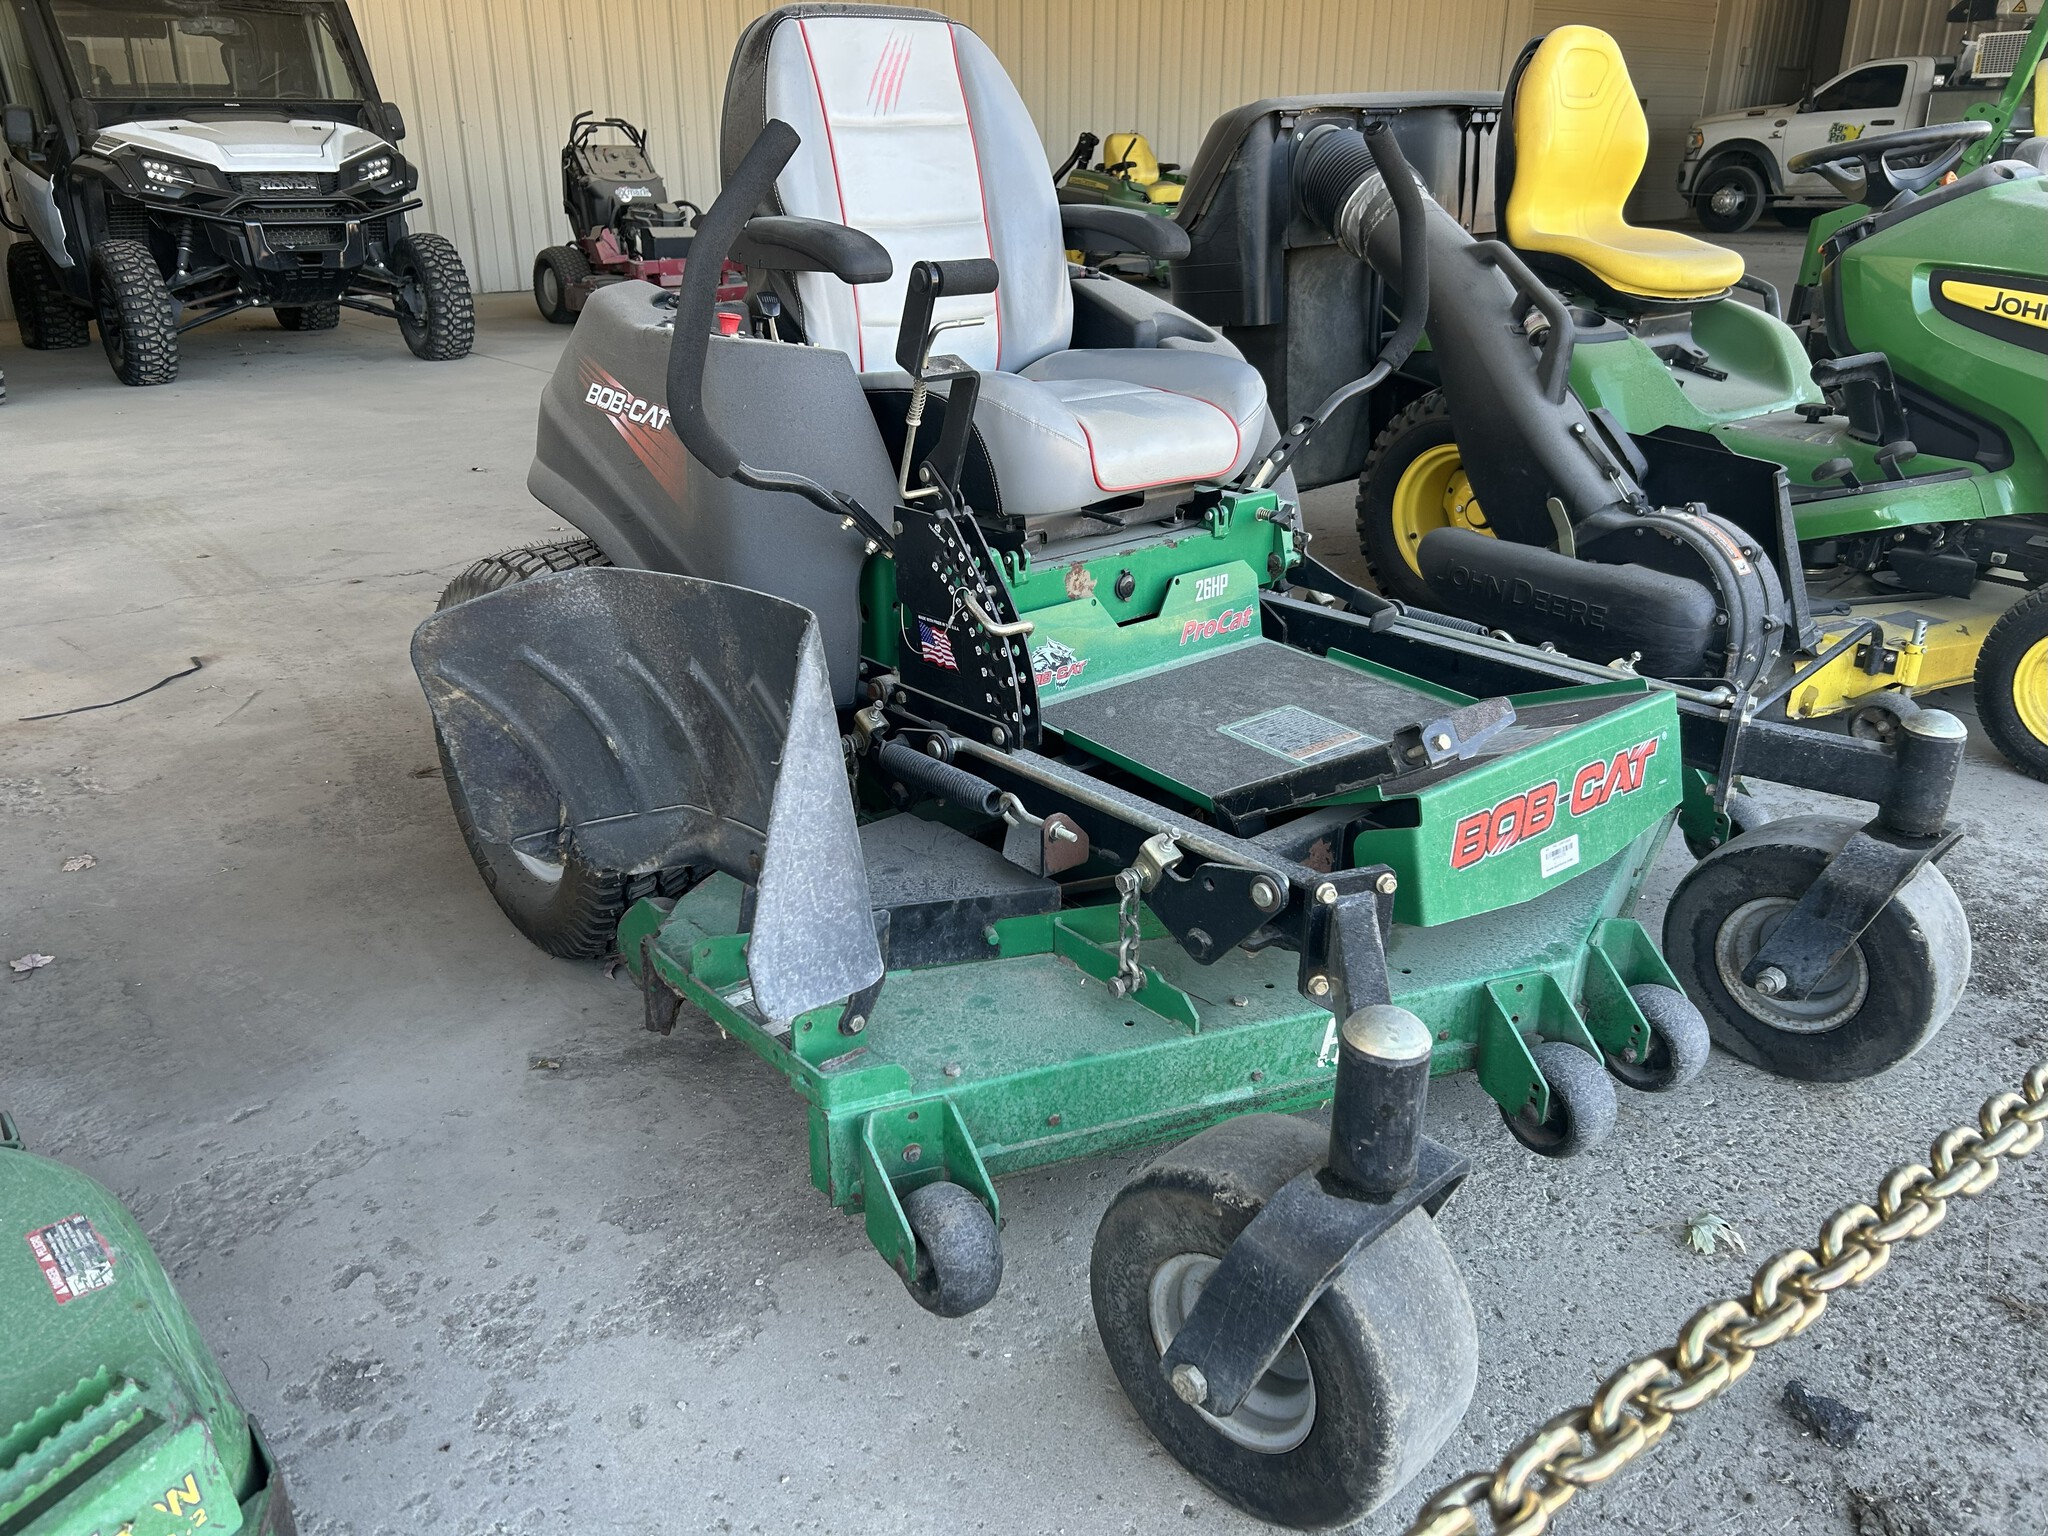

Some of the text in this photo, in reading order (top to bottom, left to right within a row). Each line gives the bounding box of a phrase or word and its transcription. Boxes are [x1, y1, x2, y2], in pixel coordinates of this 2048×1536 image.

[259, 180, 317, 190] HONDA
[1984, 291, 2048, 321] JOH
[584, 382, 671, 430] BOB-CAT
[1195, 573, 1229, 602] 26HP
[1436, 558, 1608, 632] JOHN DEERE
[1179, 603, 1254, 646] ProCat
[1450, 736, 1660, 872] BOB-CAT
